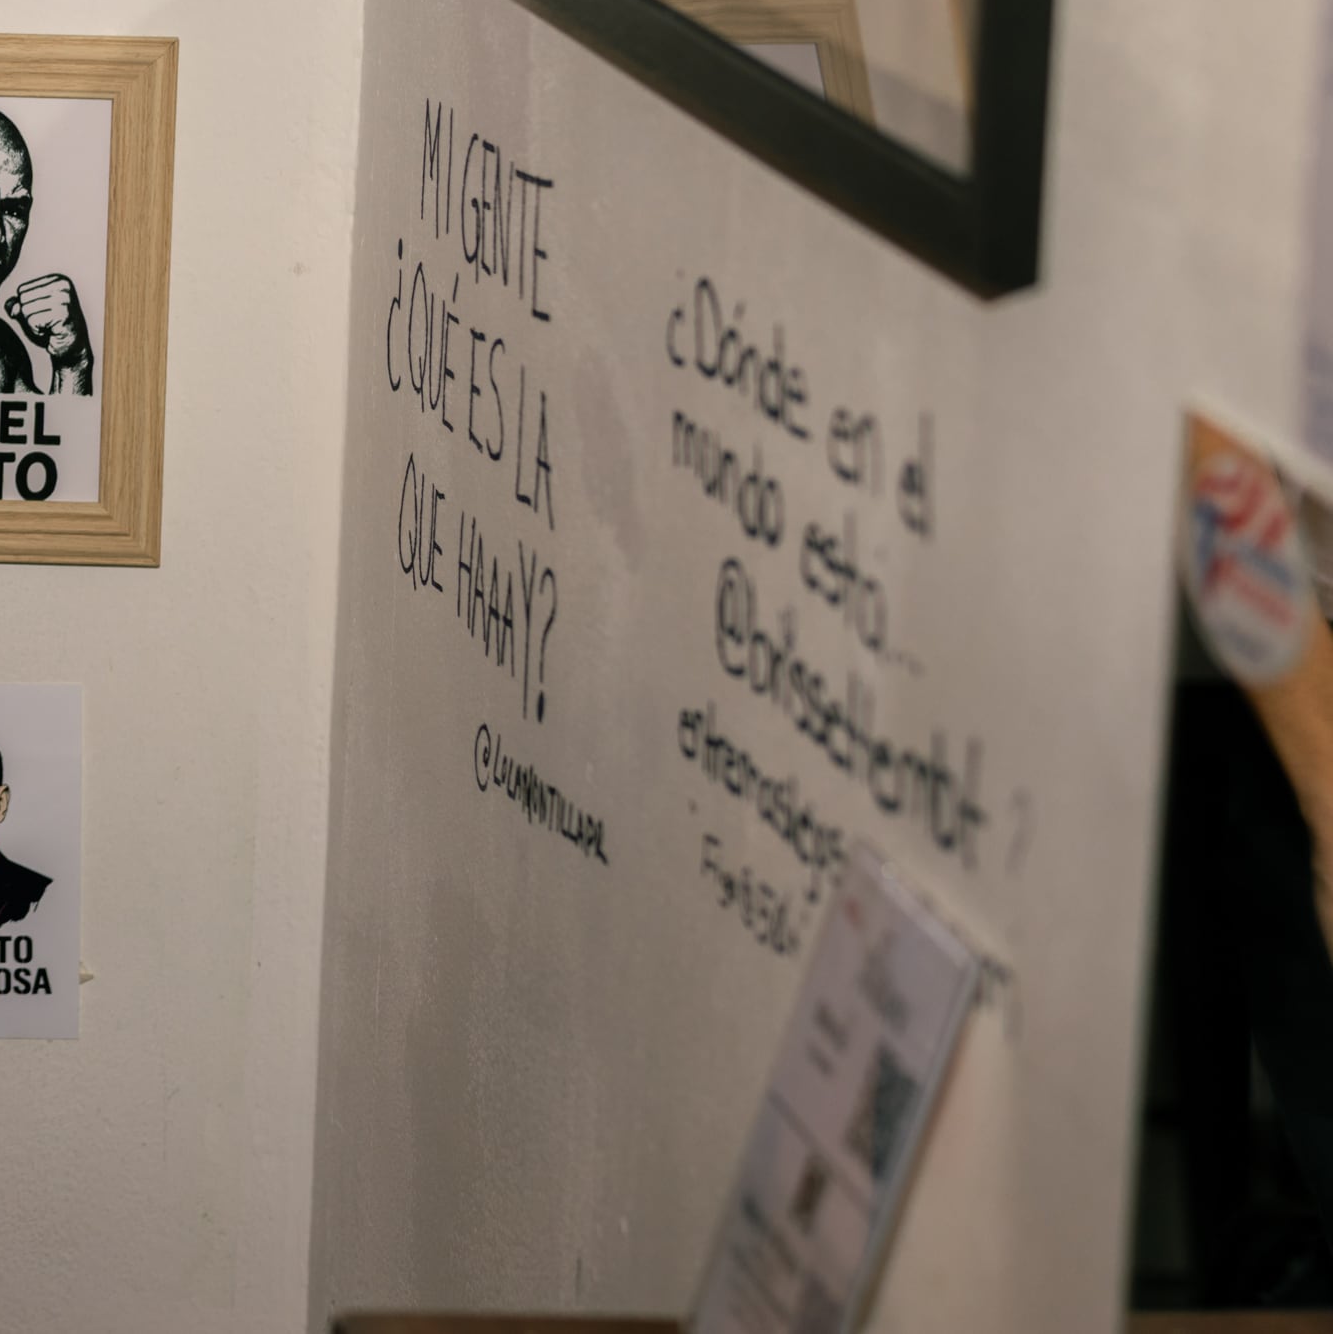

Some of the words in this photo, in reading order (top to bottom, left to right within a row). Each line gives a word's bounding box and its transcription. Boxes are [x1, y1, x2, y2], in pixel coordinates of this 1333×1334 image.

[421, 99, 454, 239] MI
[461, 133, 554, 322] GENTE
[468, 328, 506, 464] ES
[515, 366, 555, 531] LA
[671, 409, 785, 549] mundo
[829, 404, 885, 493] en
[398, 454, 444, 592] QUE
